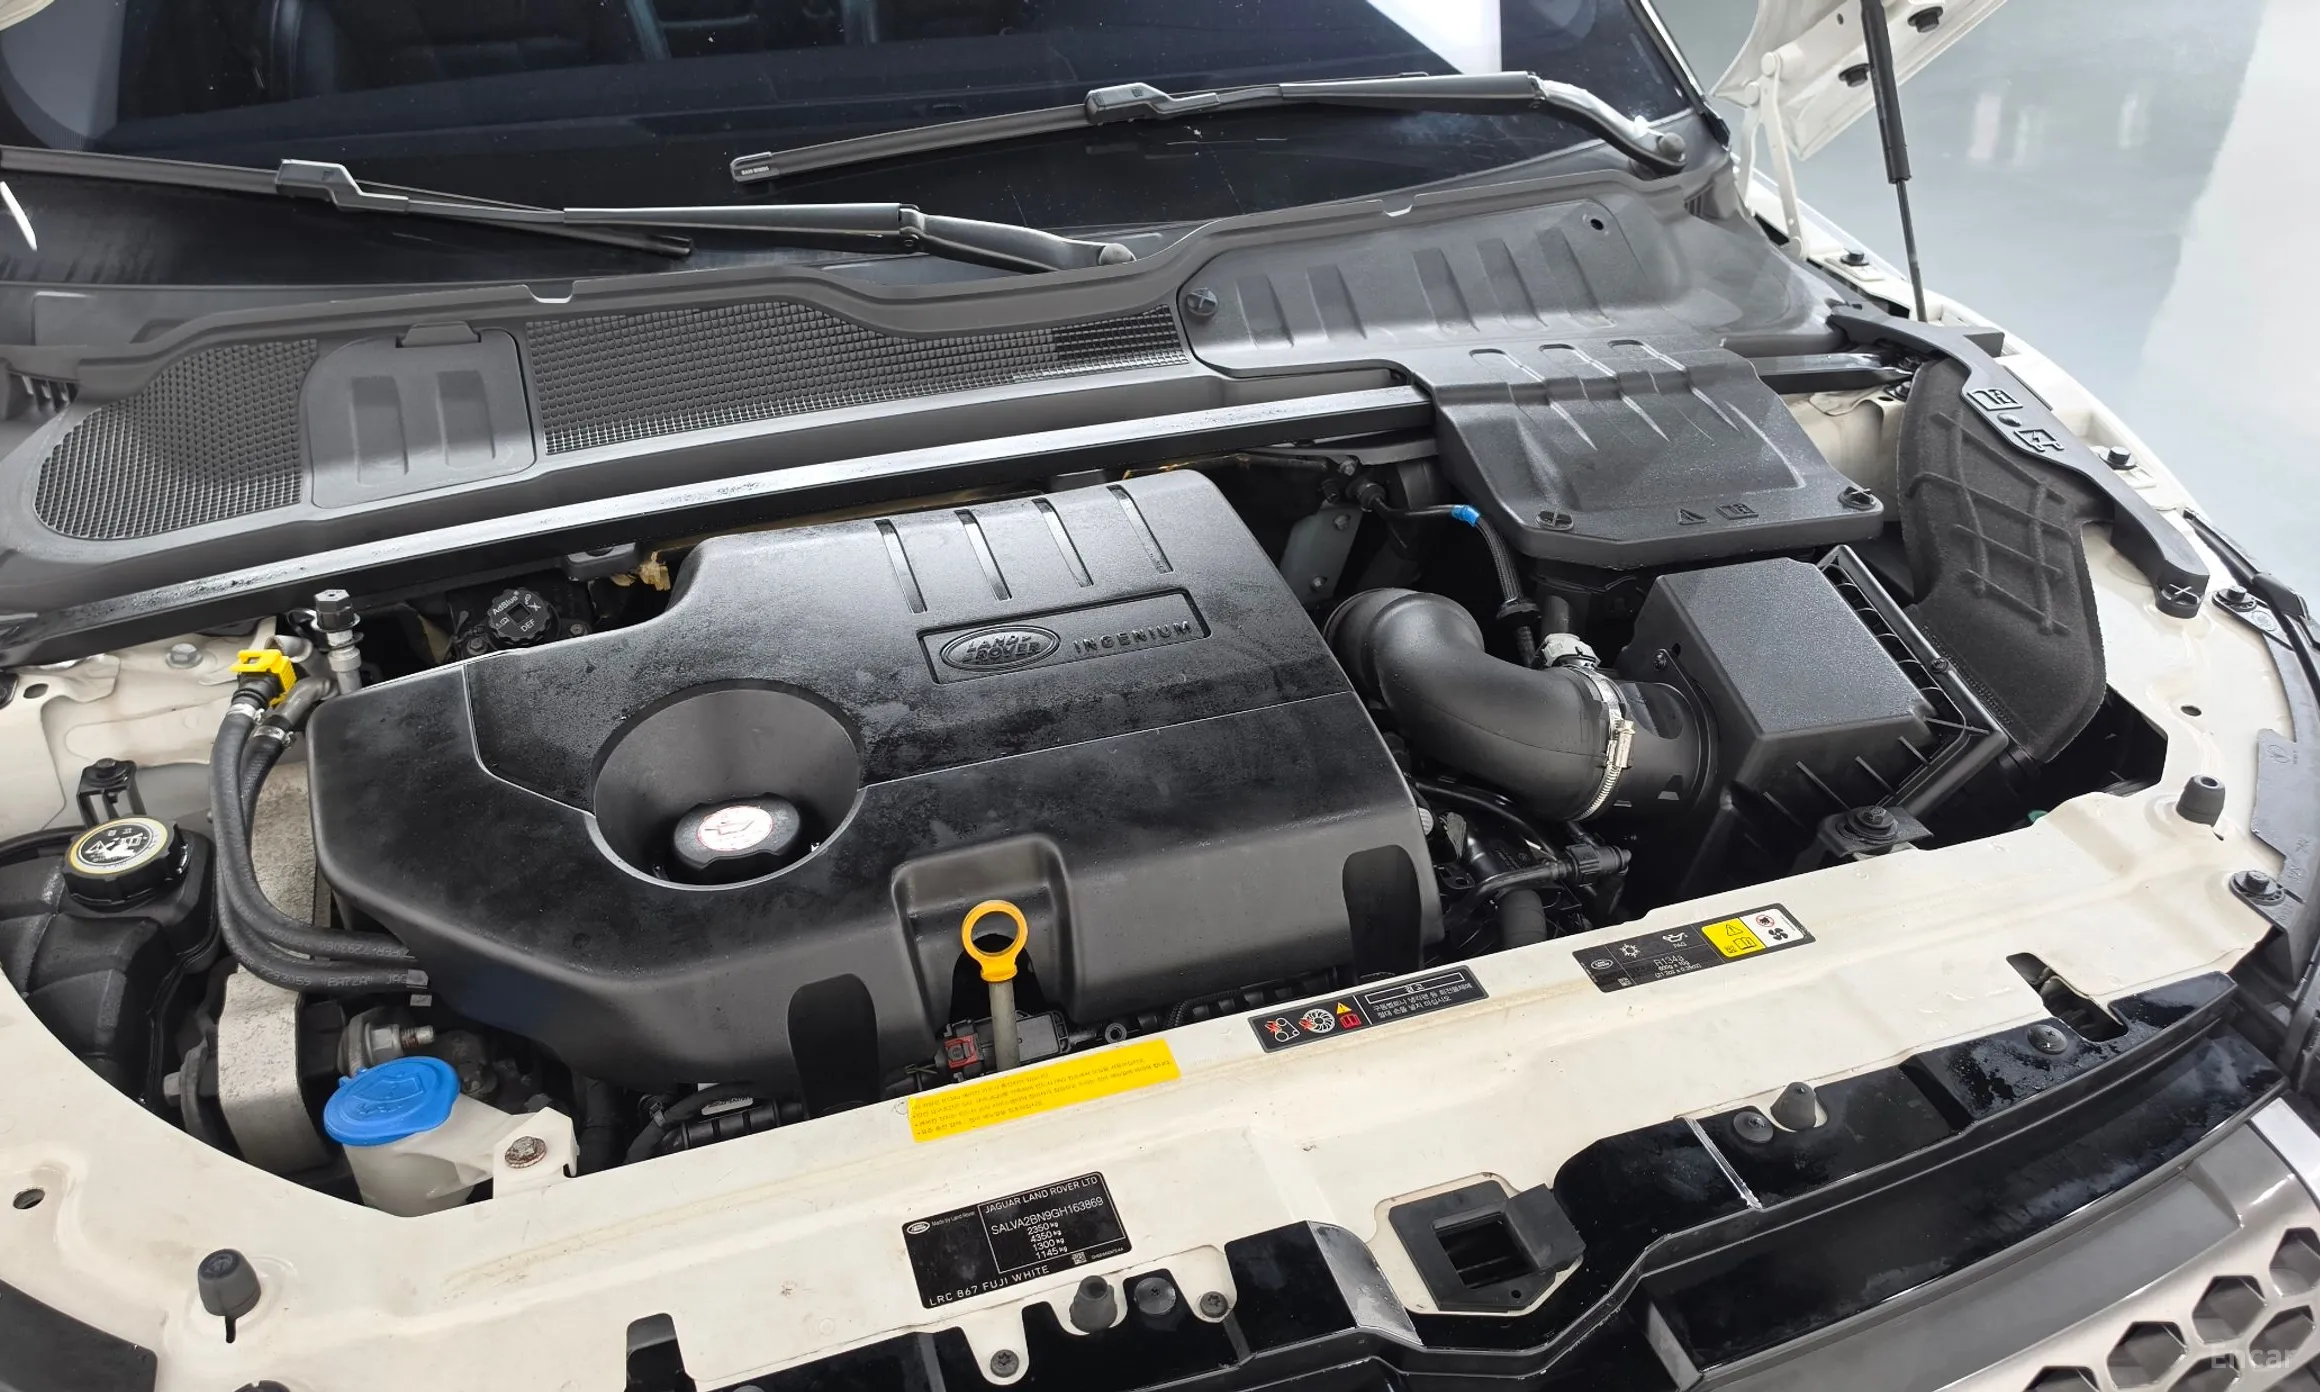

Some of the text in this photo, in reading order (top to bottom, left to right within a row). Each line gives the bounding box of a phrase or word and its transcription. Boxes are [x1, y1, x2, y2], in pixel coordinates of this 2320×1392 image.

[520, 618, 535, 632] DEF
[1073, 620, 1193, 655] INGENIUM
[1653, 955, 1685, 967] R134a
[984, 1175, 1098, 1214] JAGUAR LAND ROVER LTD
[991, 1196, 1104, 1236] SALVA2BN9GH163869
[1027, 1222, 1050, 1236] 2350
[1030, 1230, 1053, 1244] 4350
[1033, 1238, 1056, 1252] 1300
[1036, 1247, 1059, 1260] 1145
[929, 1264, 1050, 1307] LRC 867 FUJI WHITE
